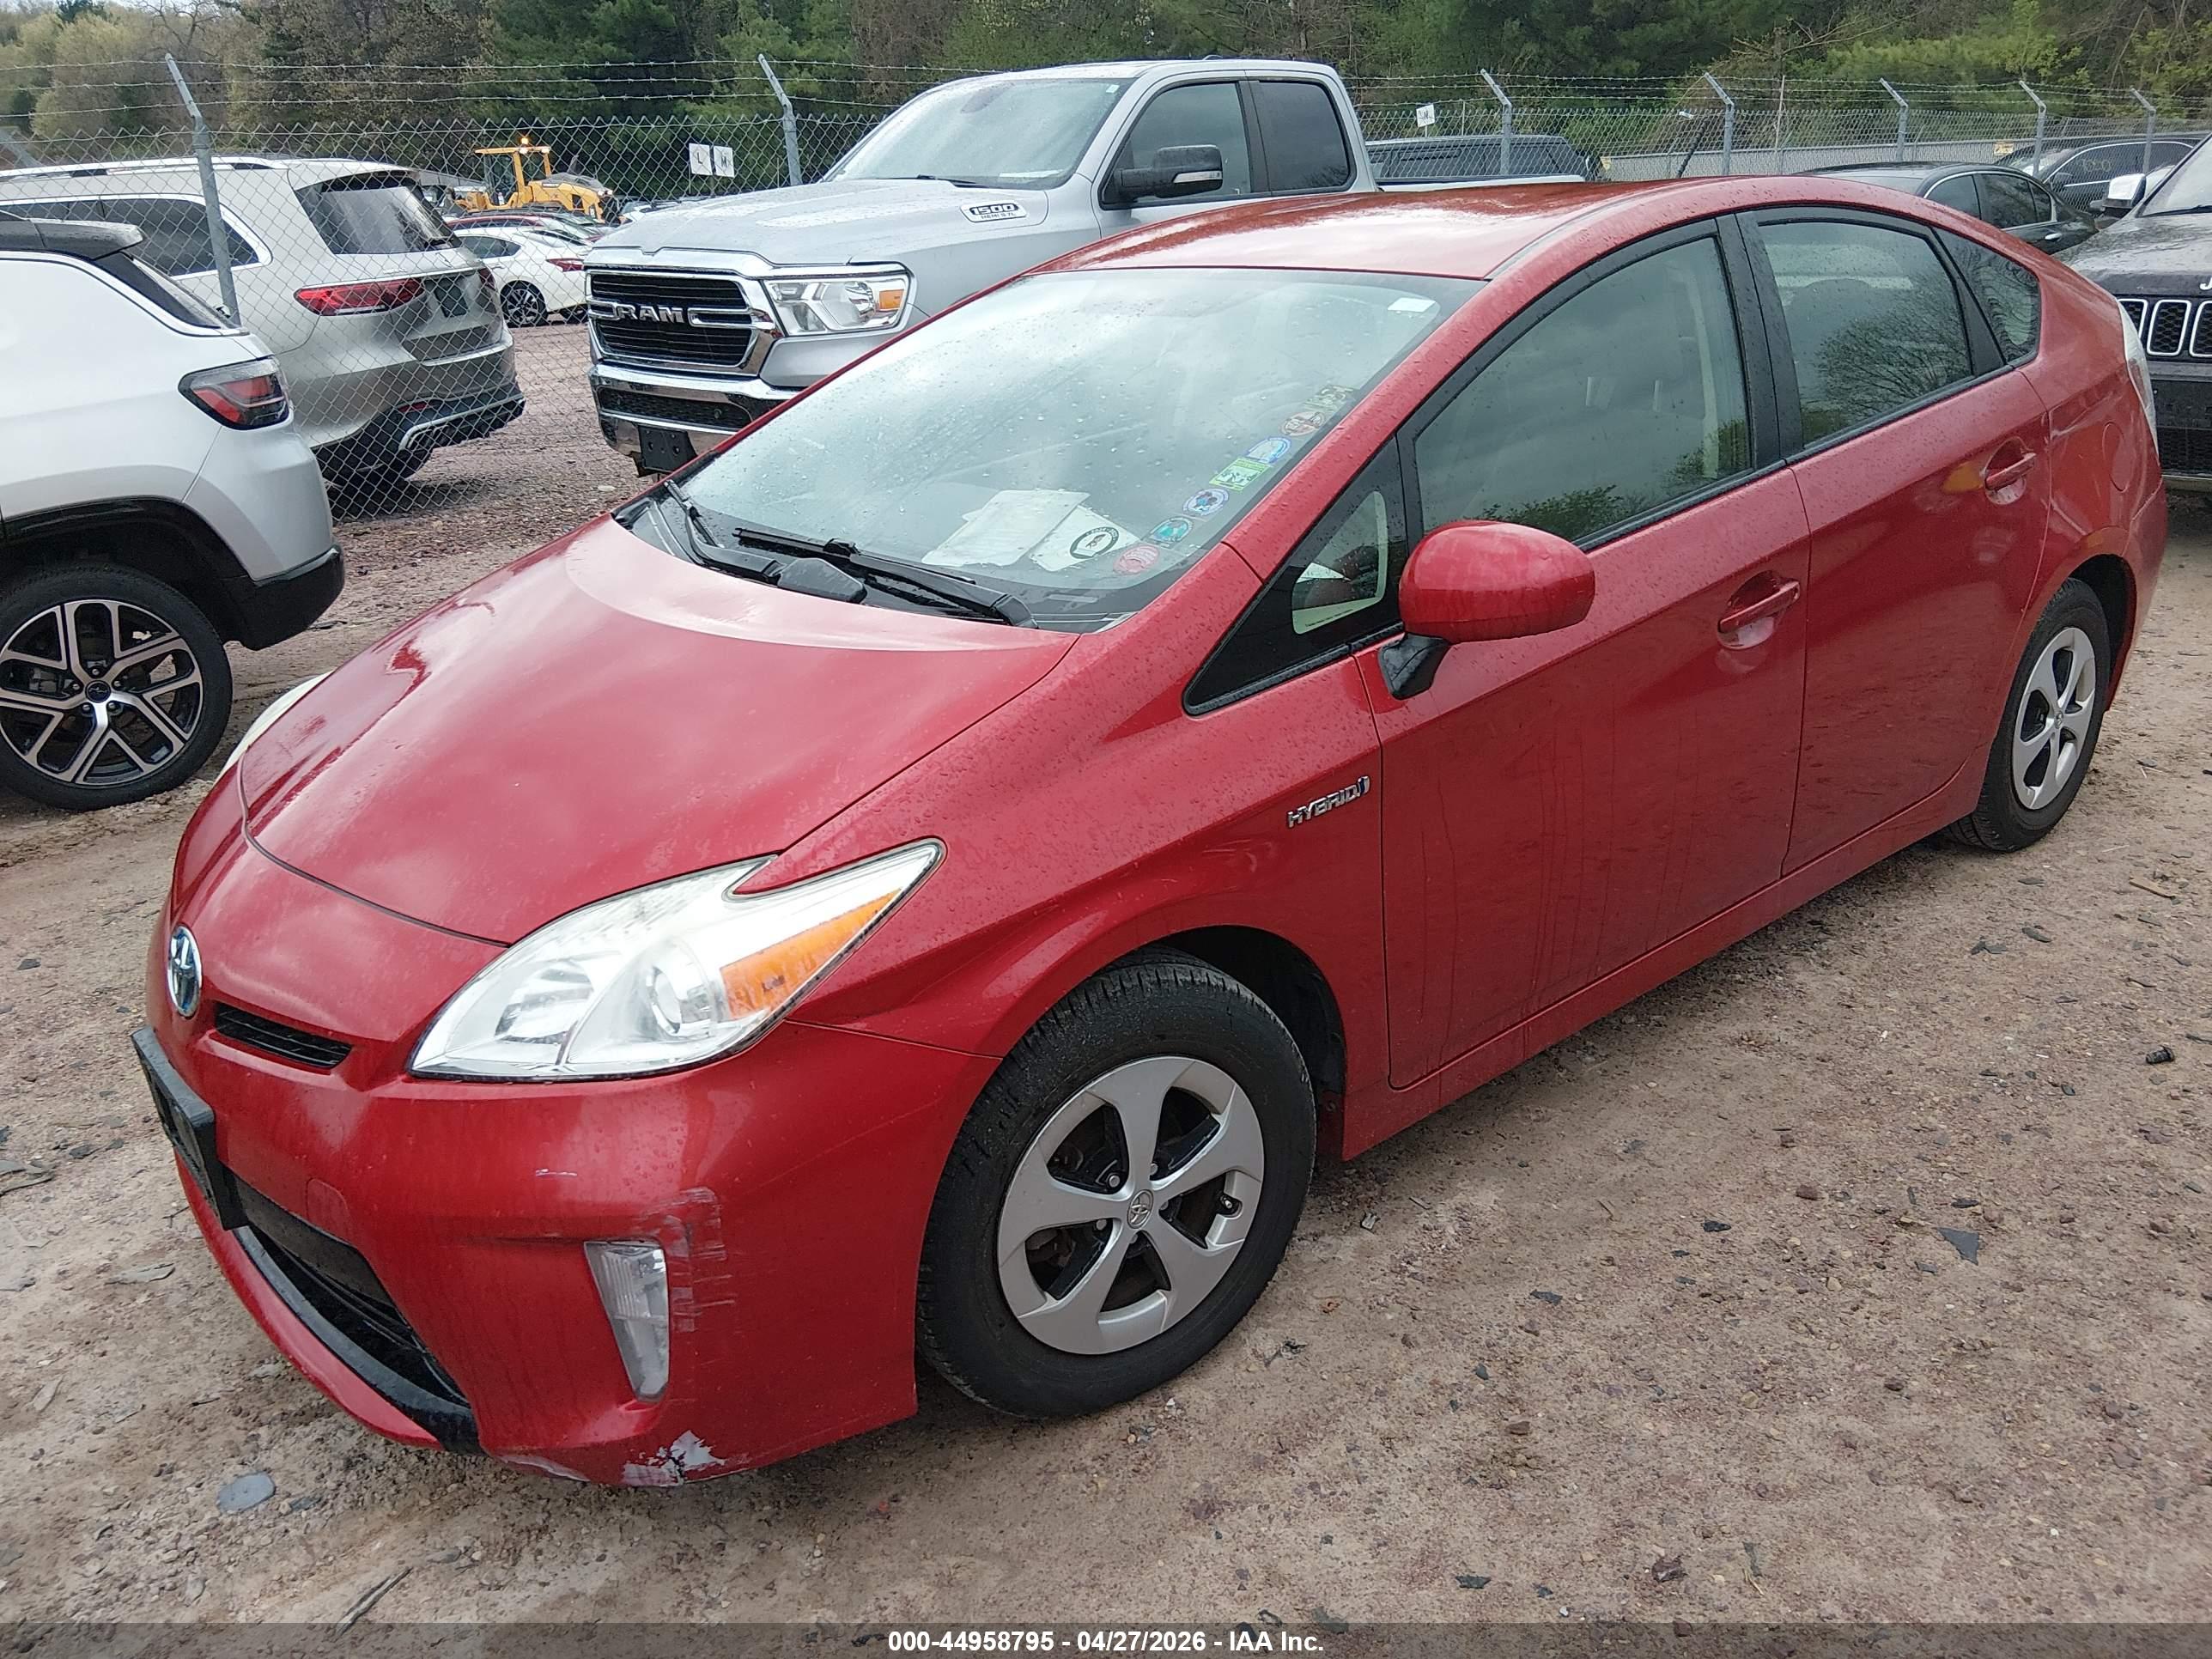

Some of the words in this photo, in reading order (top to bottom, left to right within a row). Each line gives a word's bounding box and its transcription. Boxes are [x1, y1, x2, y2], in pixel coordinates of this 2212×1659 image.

[697, 152, 703, 164] L
[971, 204, 1015, 216] 1500
[617, 304, 684, 324] RAM
[1287, 783, 1360, 829] HYBRID
